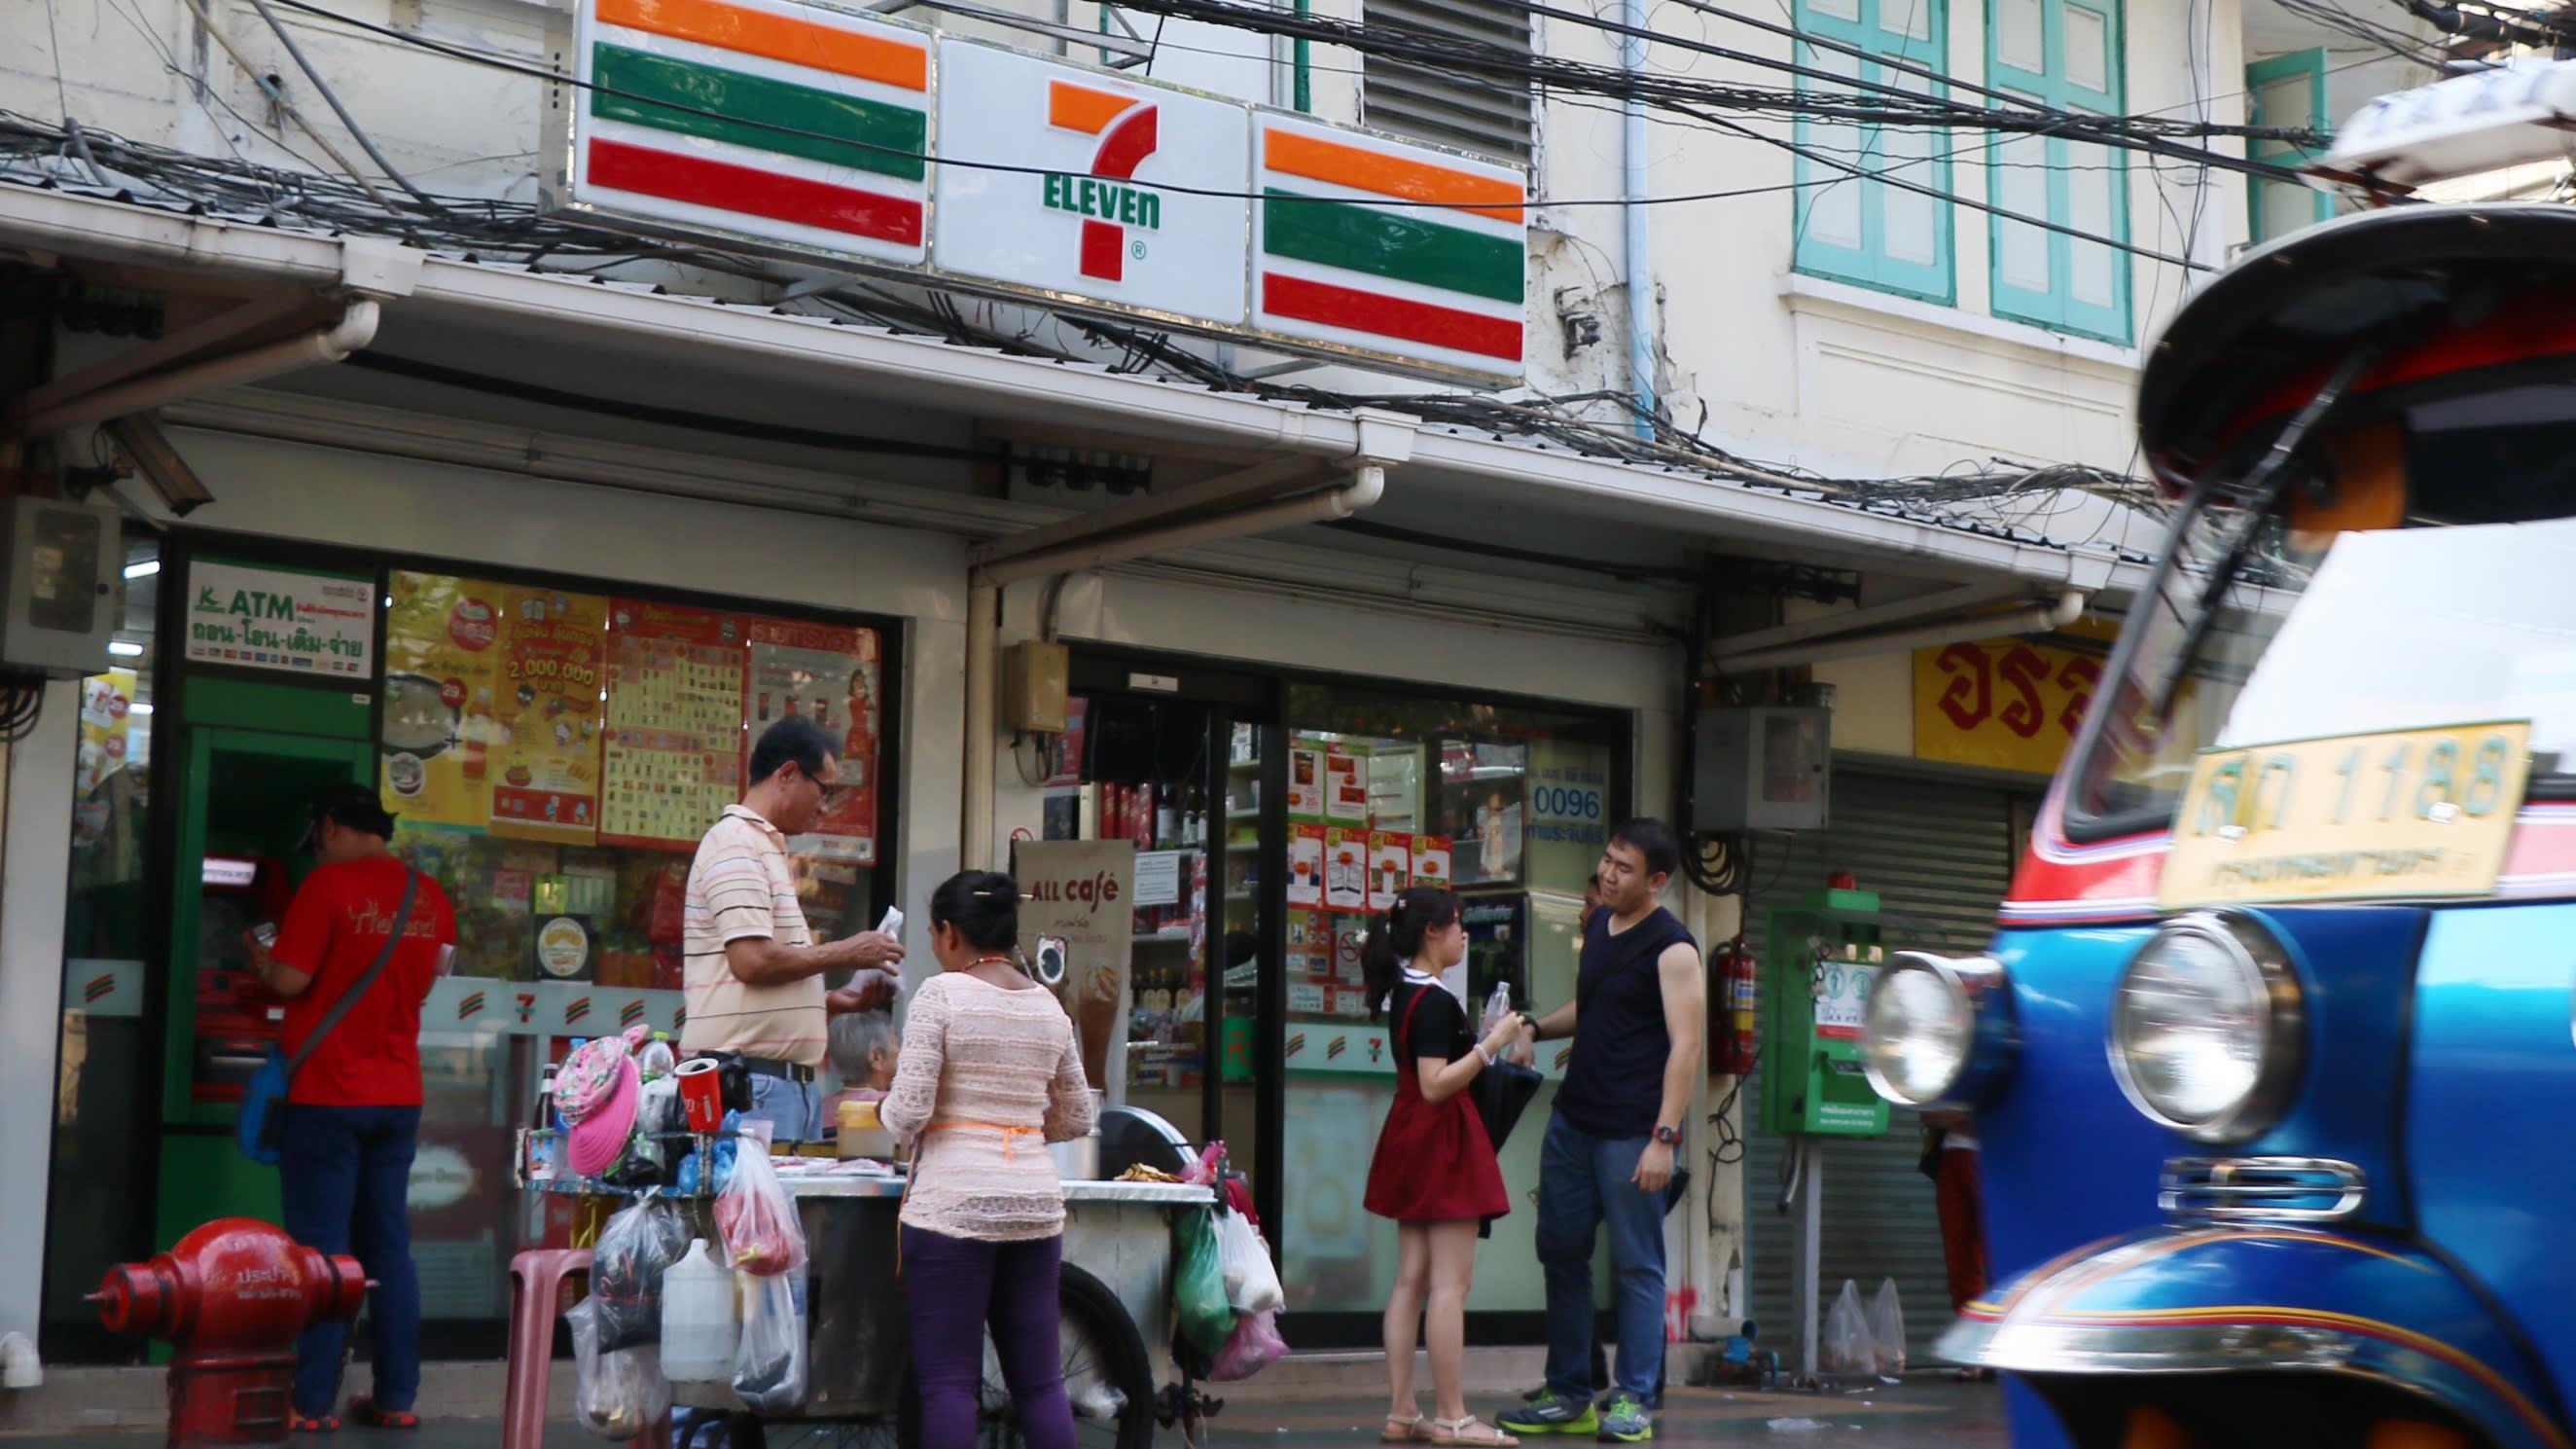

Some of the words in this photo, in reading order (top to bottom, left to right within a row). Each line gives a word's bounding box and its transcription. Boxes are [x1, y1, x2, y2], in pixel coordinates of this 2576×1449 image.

[230, 589, 296, 622] ATM
[509, 659, 594, 685] 2,000,000
[1534, 785, 1600, 819] 0096
[1031, 880, 1060, 902] ALL
[1065, 870, 1120, 914] café
